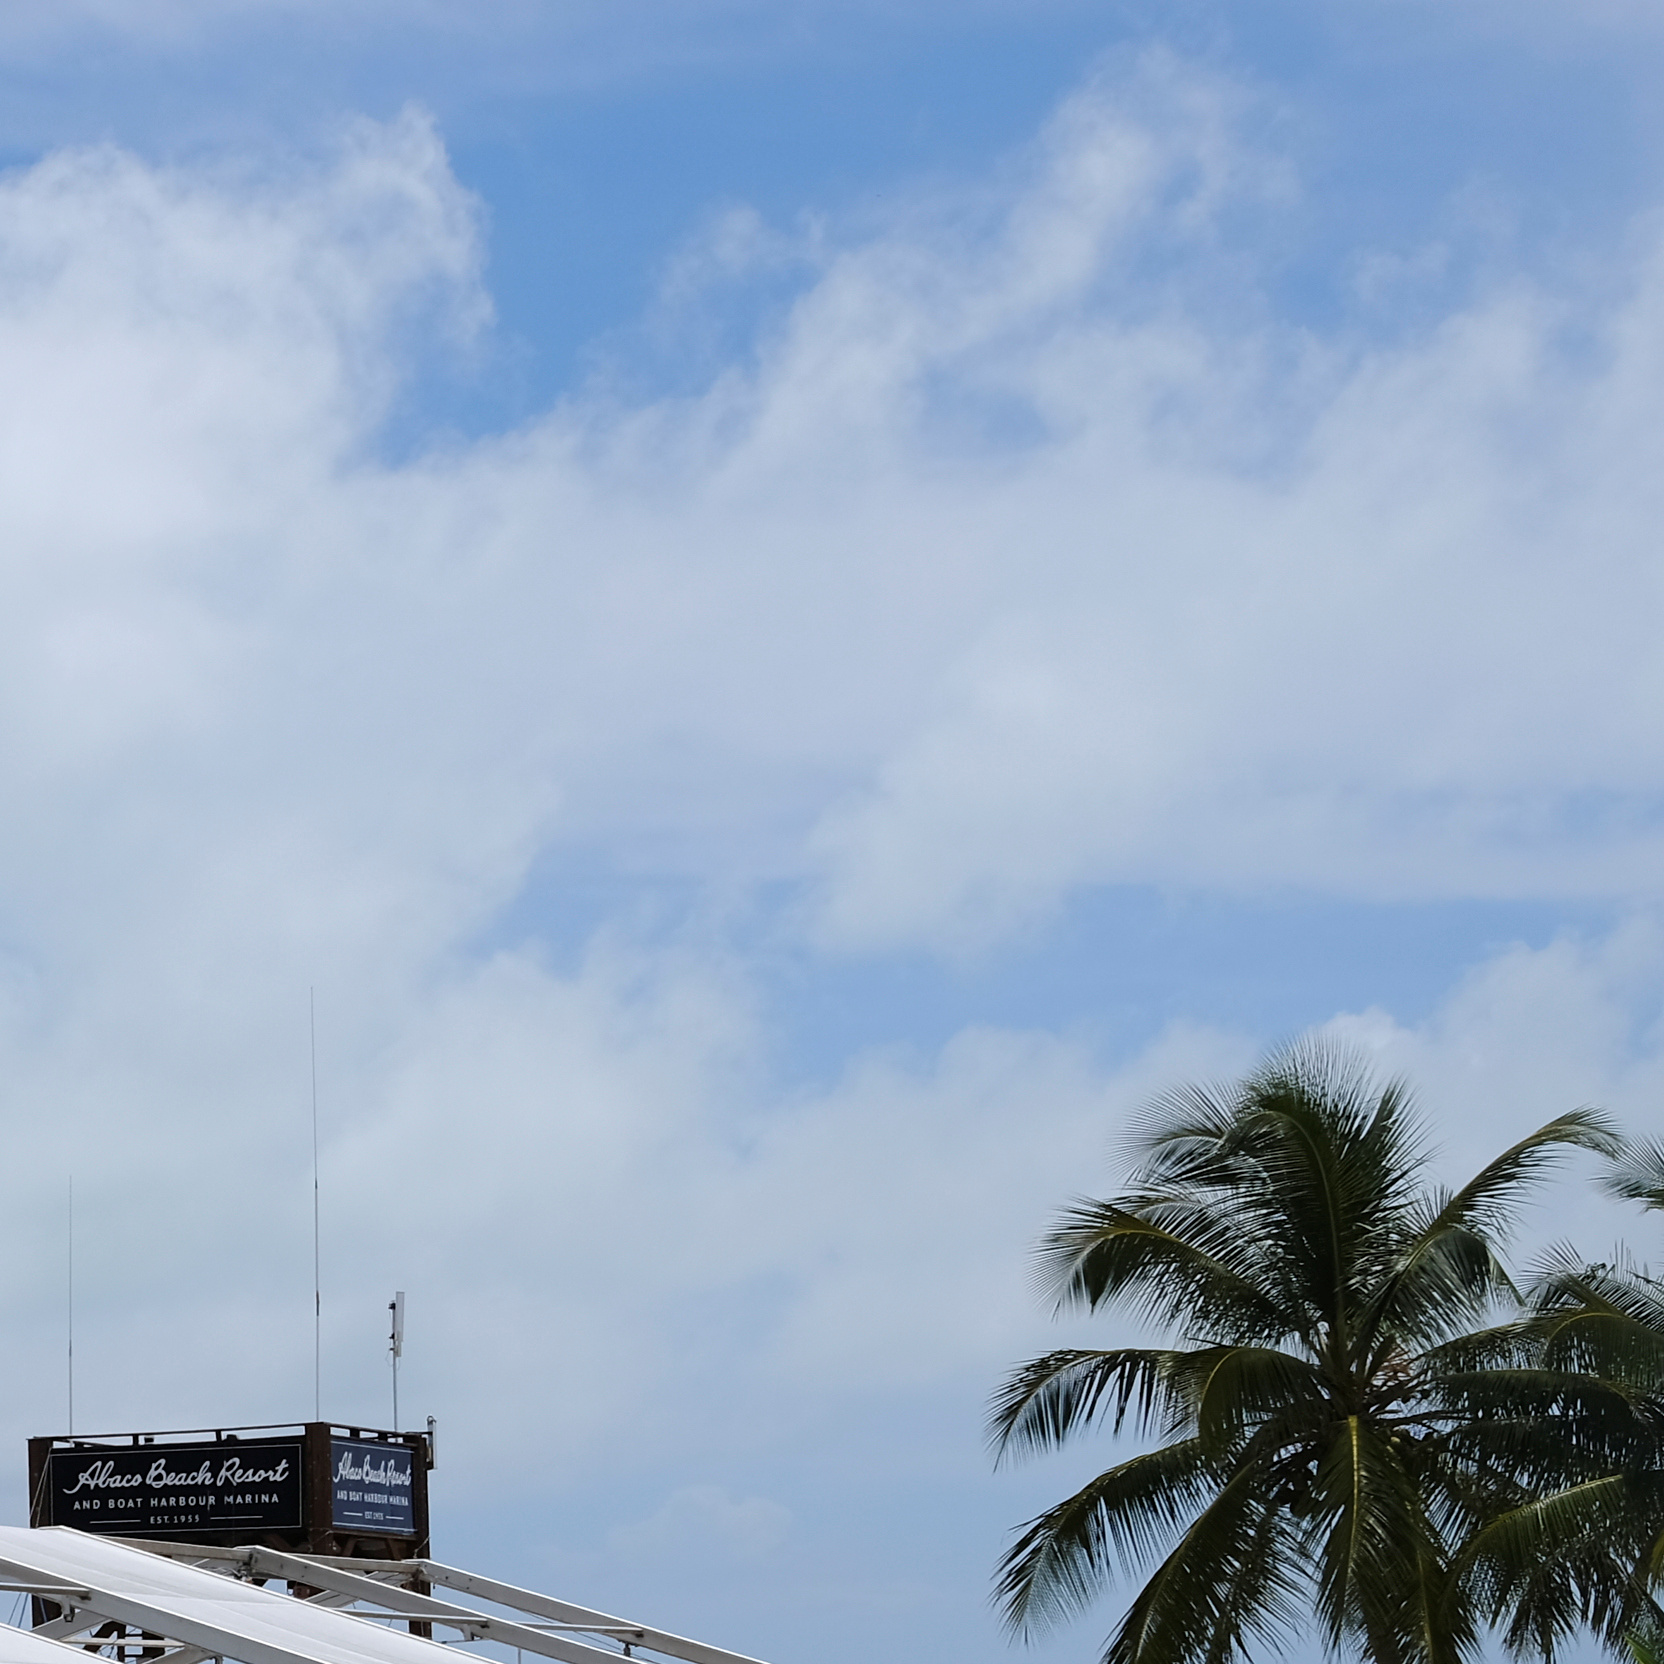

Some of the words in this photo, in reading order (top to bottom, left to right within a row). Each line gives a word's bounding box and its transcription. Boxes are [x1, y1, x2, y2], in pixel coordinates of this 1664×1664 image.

[62, 1460, 143, 1494] Abaco
[145, 1458, 214, 1489] Beach
[216, 1457, 289, 1487] Resort
[73, 1499, 101, 1511] AND
[108, 1498, 143, 1510] BOAT
[150, 1495, 216, 1508] HARBOUR
[224, 1493, 279, 1505] MARINA
[150, 1516, 171, 1524] EST.
[173, 1514, 200, 1523] 1955
